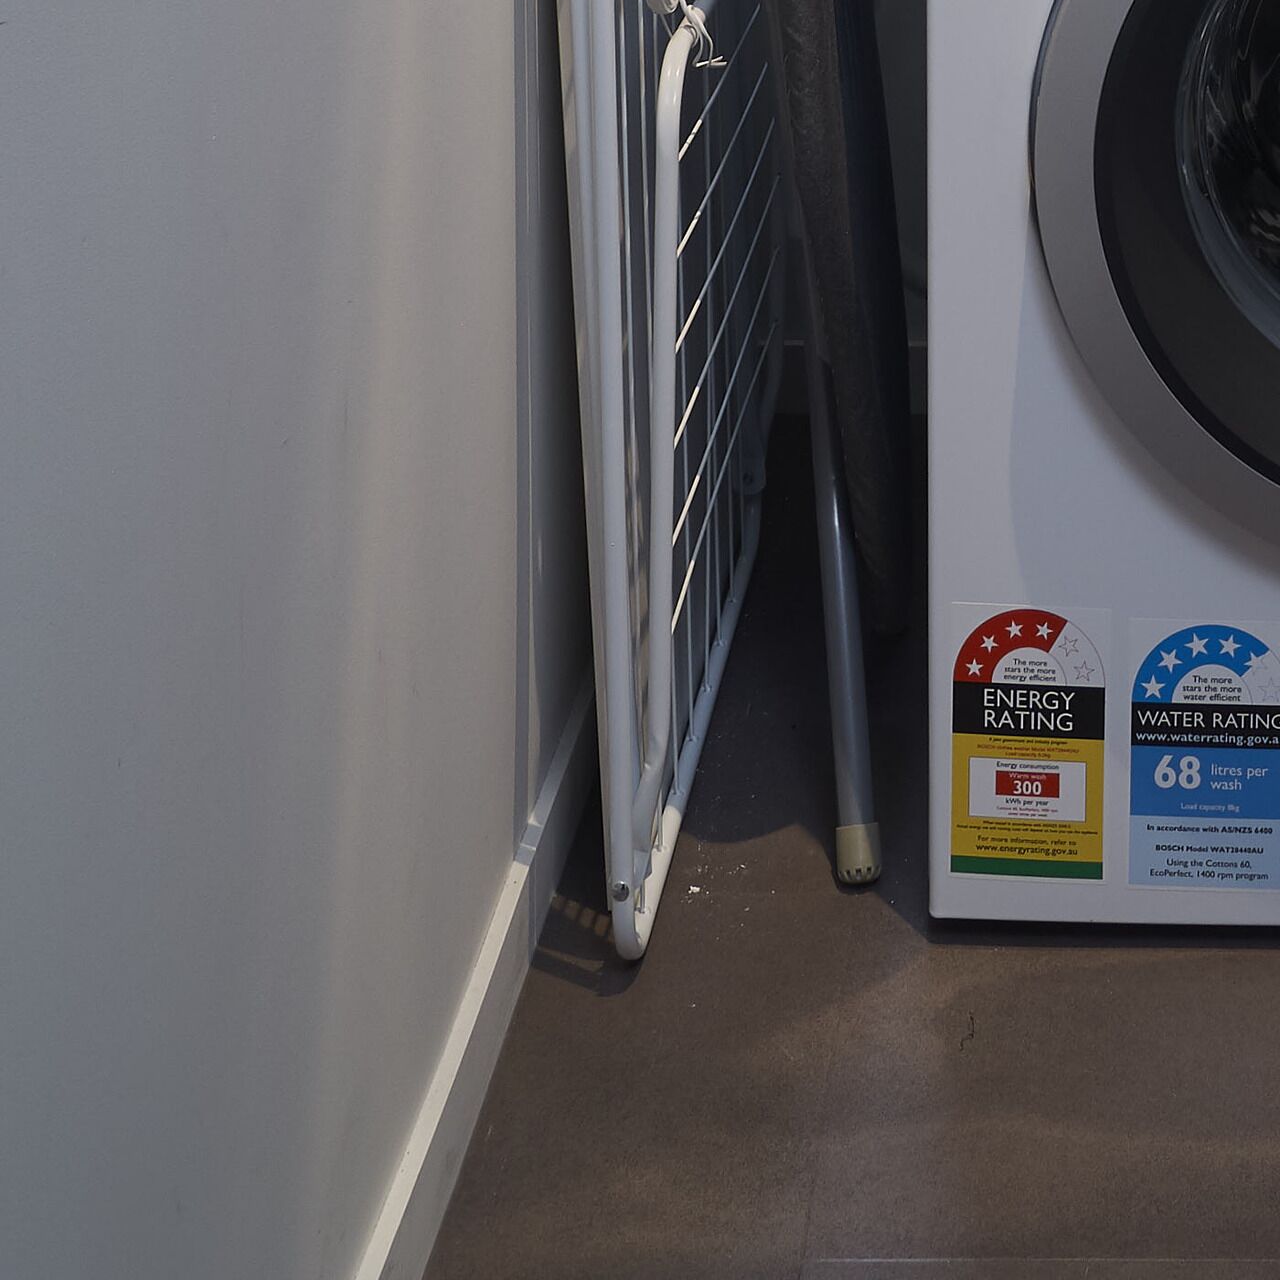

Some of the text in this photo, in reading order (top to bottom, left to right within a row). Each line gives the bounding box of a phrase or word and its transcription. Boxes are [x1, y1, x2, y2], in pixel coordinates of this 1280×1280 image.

[1004, 674, 1027, 682] energy
[1192, 675, 1232, 684] The more
[983, 688, 1075, 710] ENERGY
[1183, 693, 1241, 702] water efficient
[984, 709, 1073, 731] RATING
[1137, 710, 1205, 728] WATER
[996, 761, 1017, 769] Energy
[1154, 755, 1268, 789] 68 litres per
[1013, 780, 1042, 795] 300
[1210, 779, 1242, 790] wash
[1181, 802, 1197, 810] Load
[1199, 804, 1225, 812] capacity
[1157, 824, 1200, 833] accordance
[1202, 825, 1219, 833] with
[1221, 826, 1252, 834] AS/NZS
[976, 845, 1078, 856] www.energyrating.gov.au
[1166, 859, 1188, 868] Using
[1205, 860, 1238, 868] Cottons
[1236, 873, 1269, 881] program
